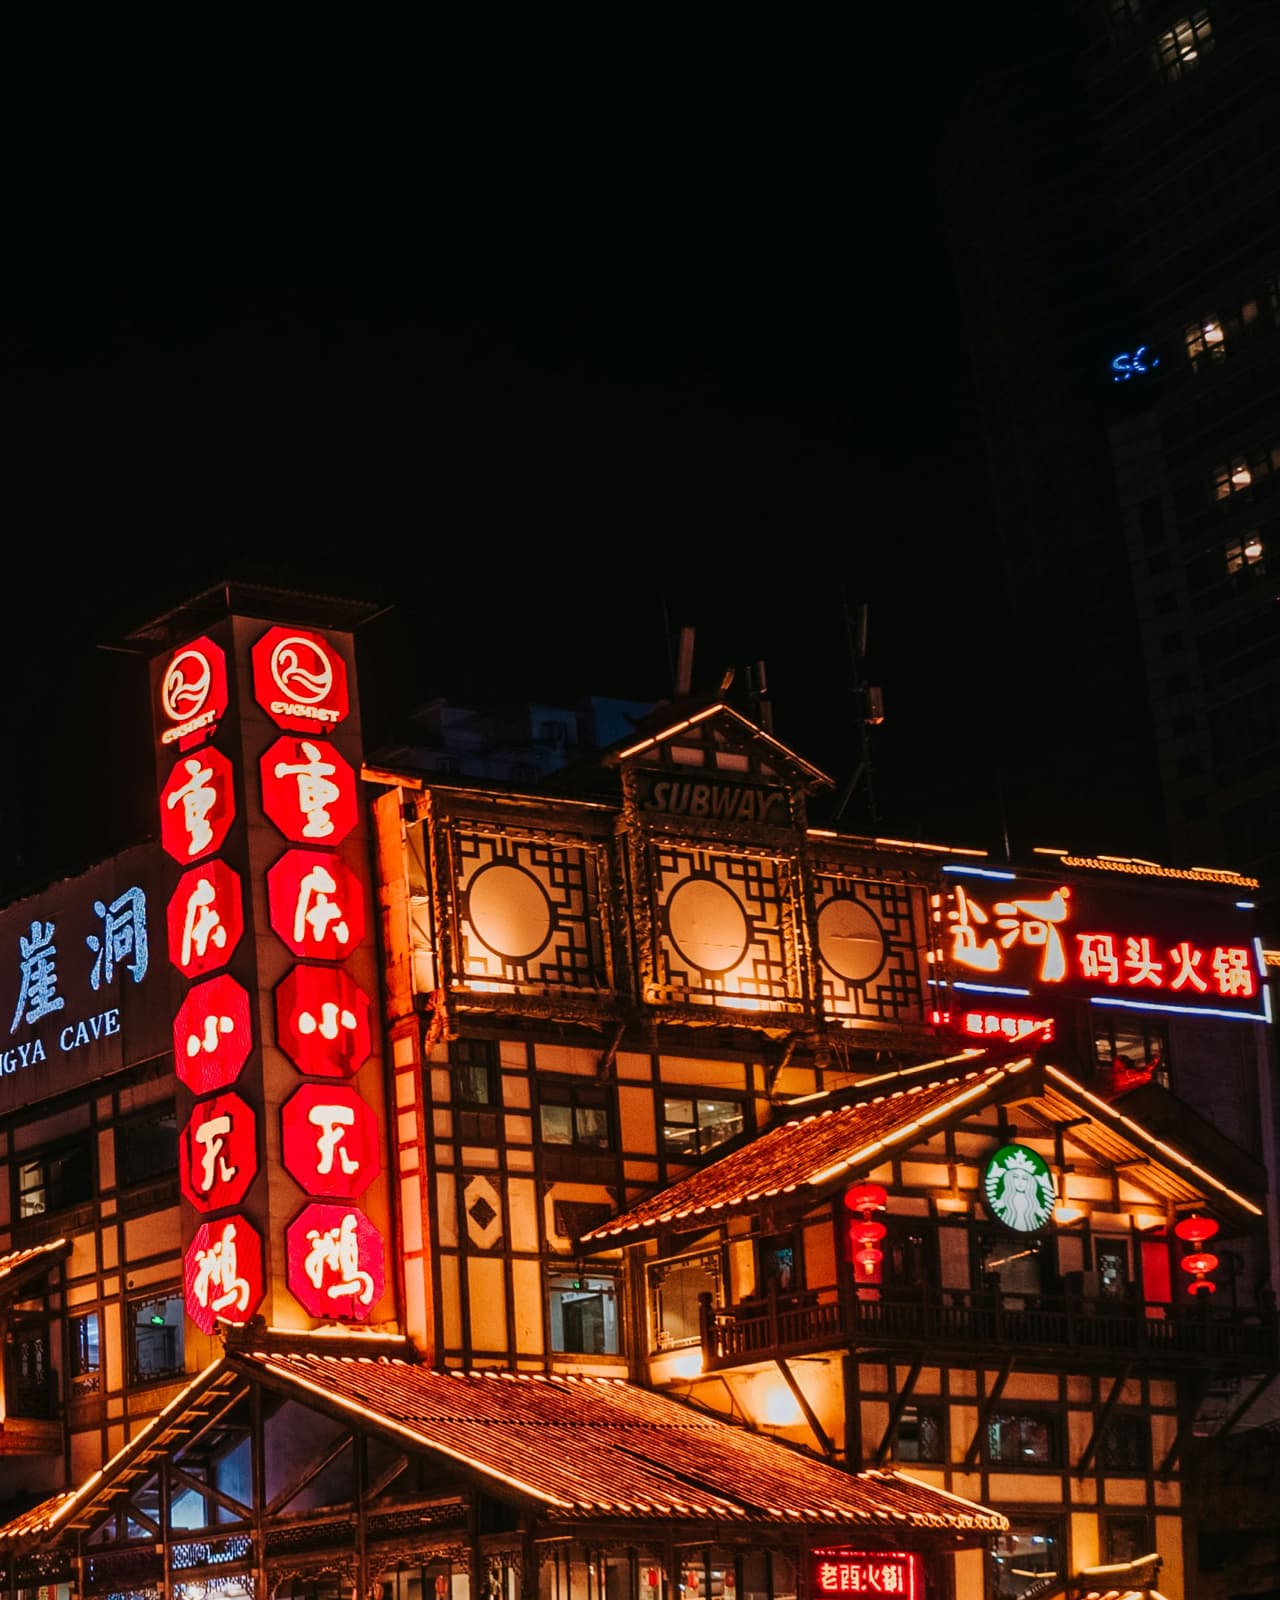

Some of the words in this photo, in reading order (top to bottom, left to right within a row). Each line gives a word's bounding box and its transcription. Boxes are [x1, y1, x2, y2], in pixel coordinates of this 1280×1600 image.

[643, 780, 786, 824] SUBWAY
[59, 1007, 121, 1054] CAVE
[273, 740, 374, 1304] 重庆小天鹅
